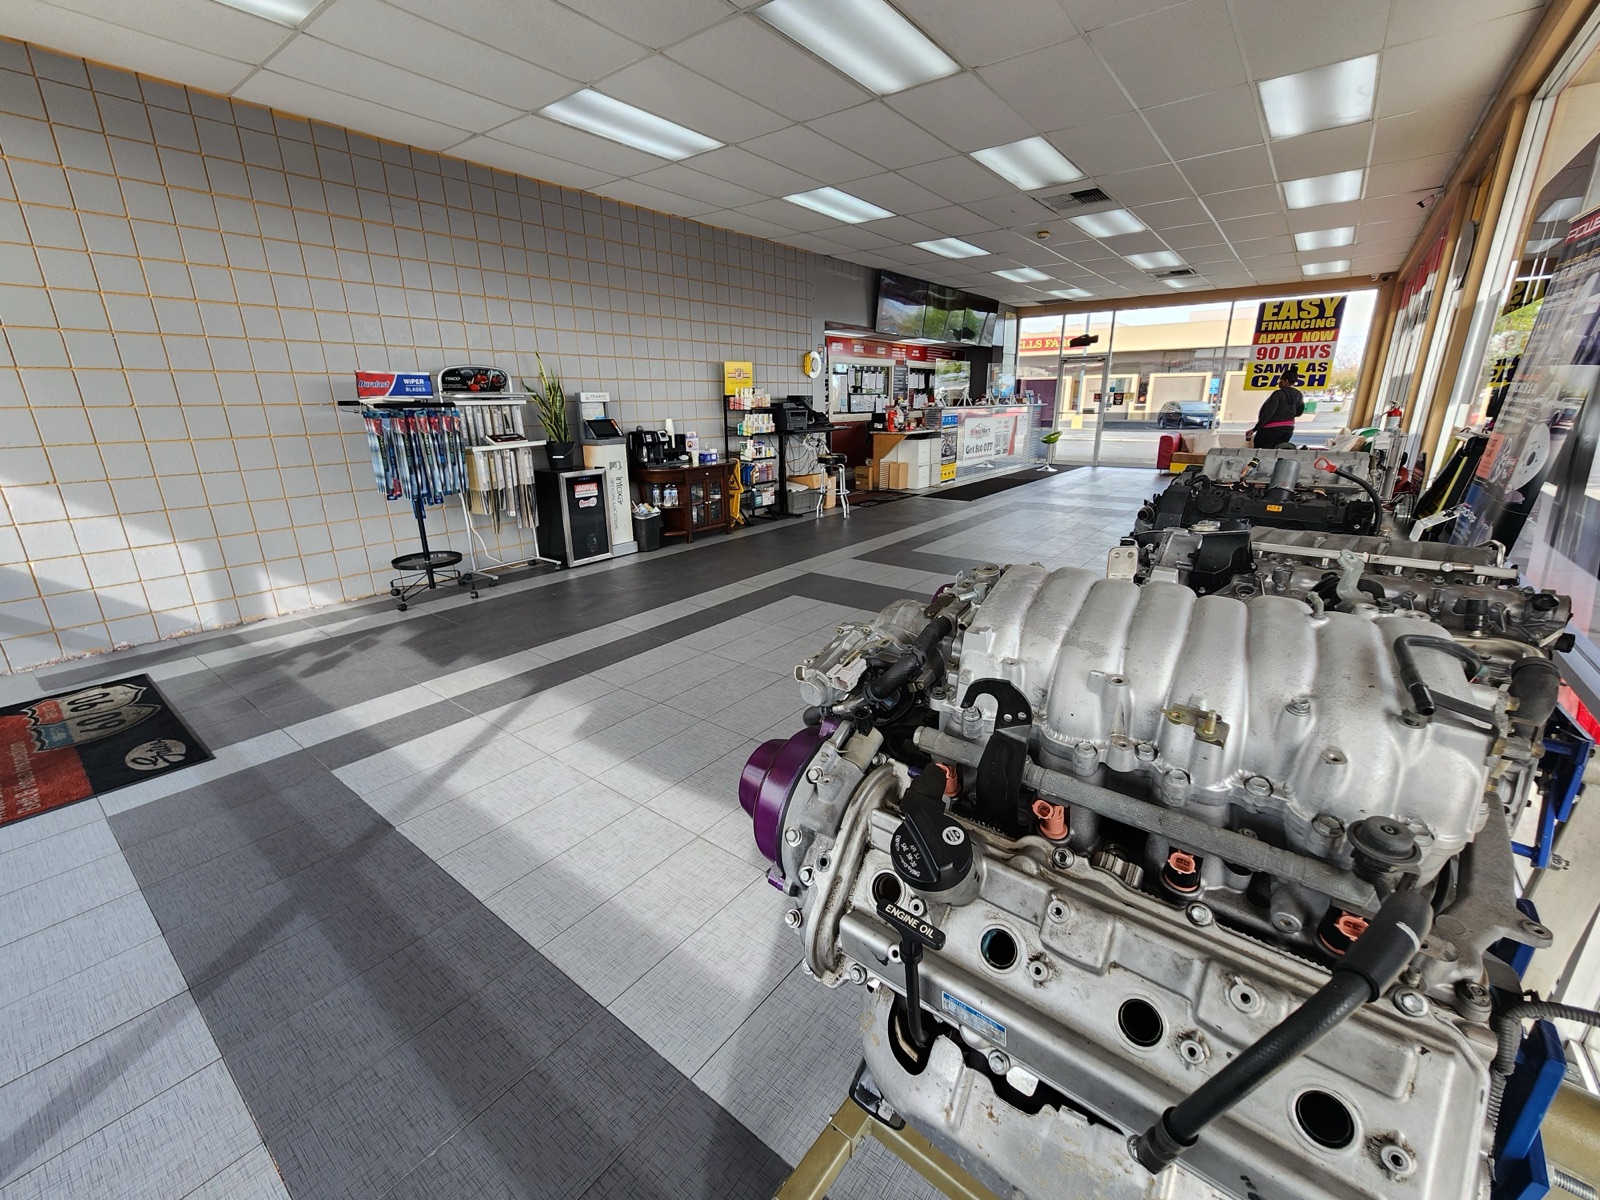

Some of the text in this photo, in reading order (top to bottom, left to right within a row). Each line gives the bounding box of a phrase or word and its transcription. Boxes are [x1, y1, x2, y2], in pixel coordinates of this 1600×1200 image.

[1263, 296, 1342, 320] EASY
[1261, 318, 1336, 331] FINANCING
[1258, 331, 1335, 344] APPLY NOW
[1256, 344, 1332, 360] 90 DAYS
[1305, 362, 1328, 372] AS
[358, 380, 390, 388] Duralast
[67, 692, 115, 712] 90
[900, 842, 909, 852] SAE
[885, 904, 934, 939] ENGINE OIL
